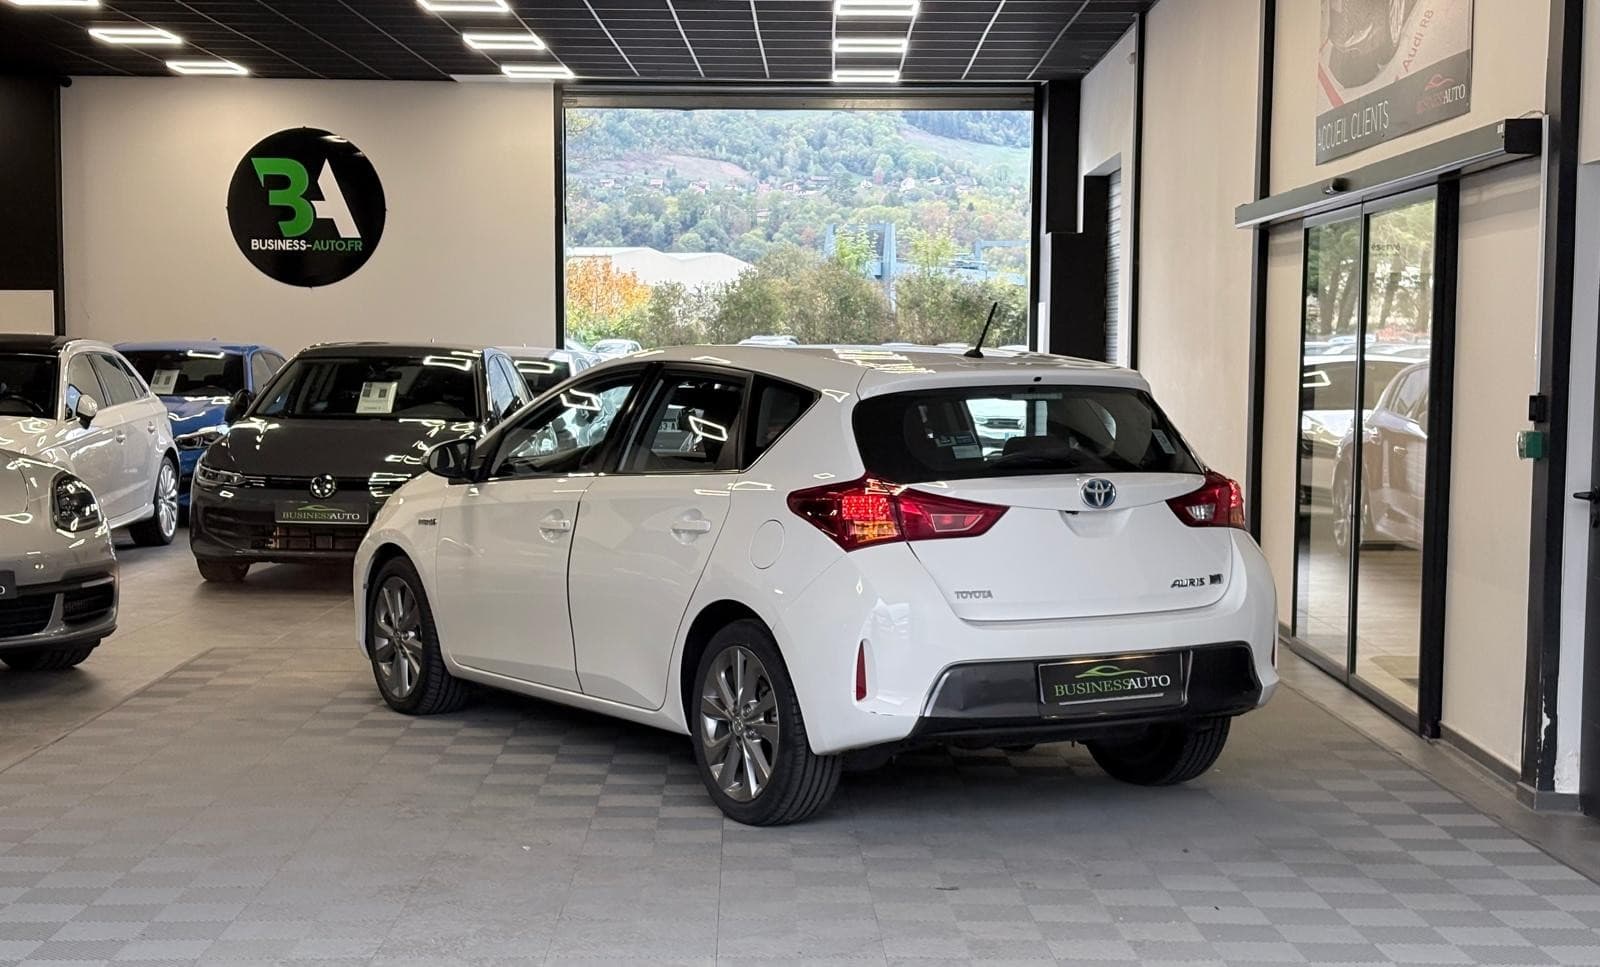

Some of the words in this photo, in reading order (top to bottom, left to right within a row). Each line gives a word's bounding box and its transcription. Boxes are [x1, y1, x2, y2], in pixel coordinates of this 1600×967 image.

[1317, 117, 1349, 152] ACCUEIL
[1351, 100, 1390, 141] CLIENTS
[250, 238, 364, 252] BUSINESS-AUTO.FR
[1170, 577, 1206, 589] AURIS
[954, 590, 994, 600] TOYOTA
